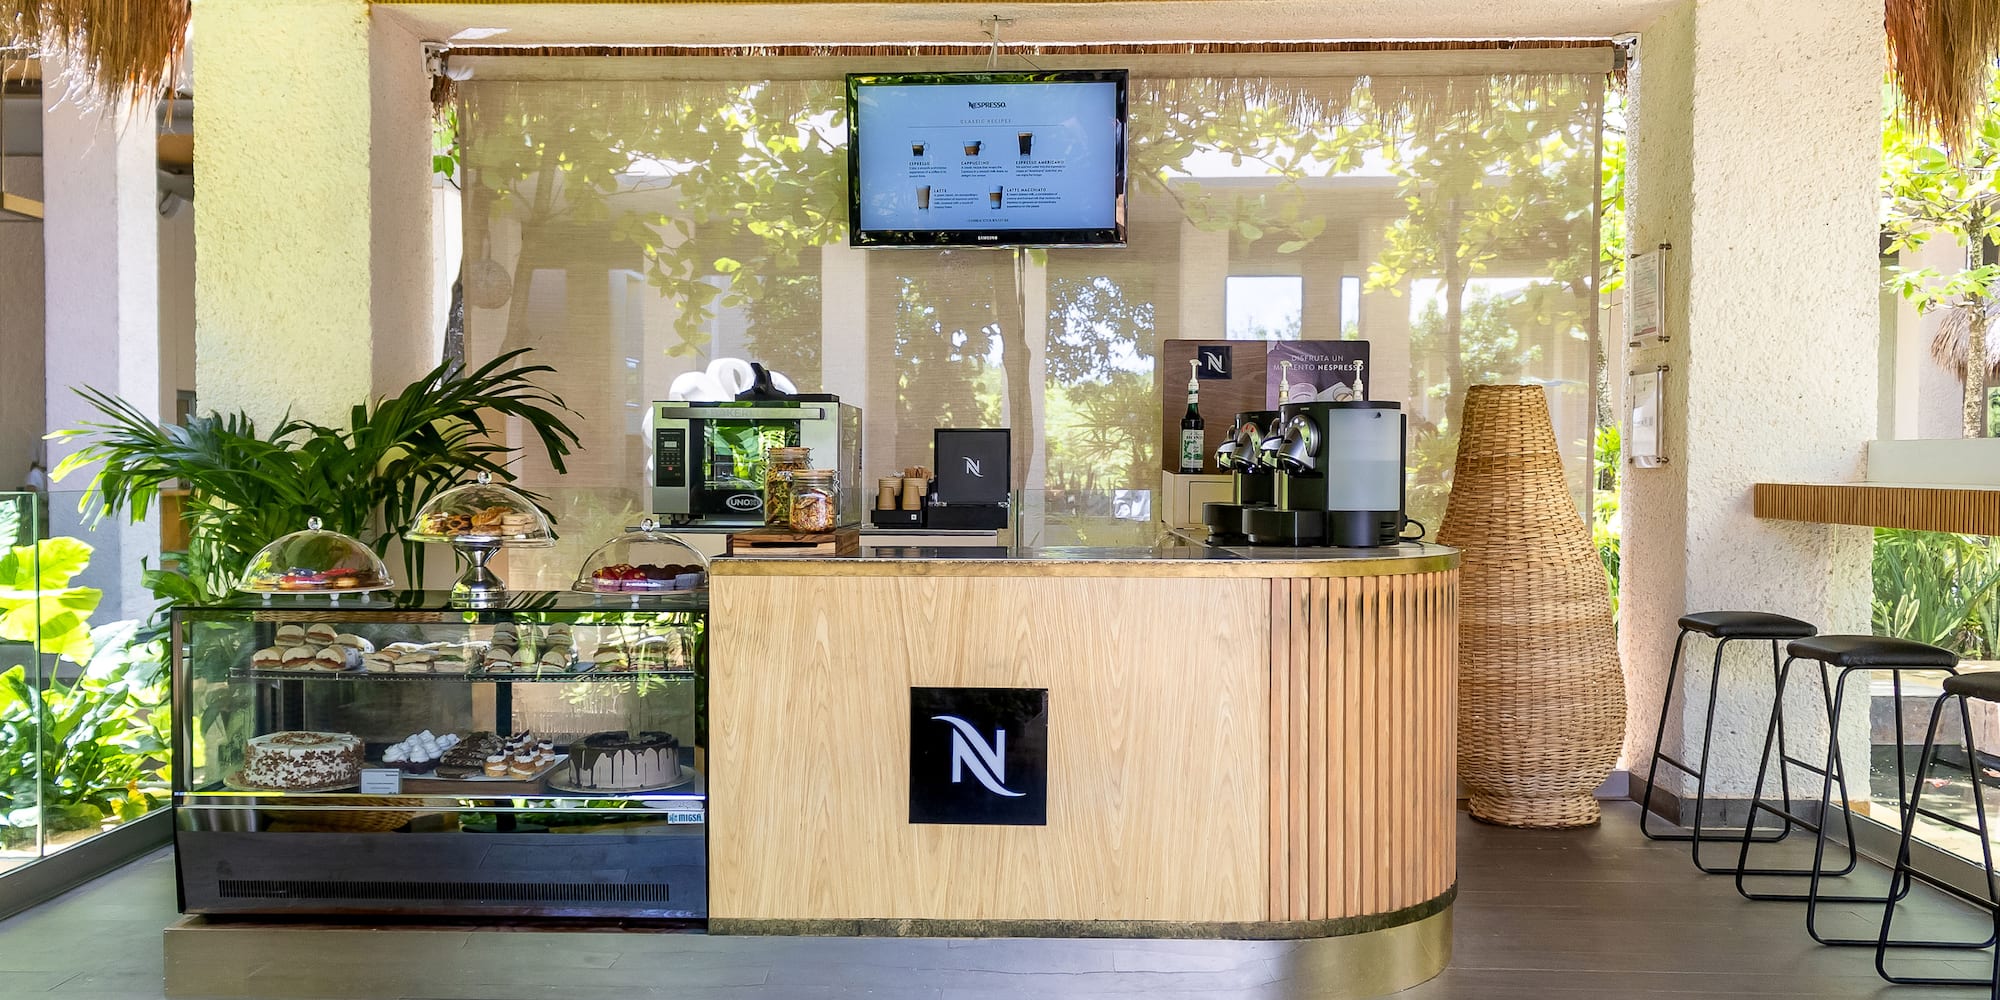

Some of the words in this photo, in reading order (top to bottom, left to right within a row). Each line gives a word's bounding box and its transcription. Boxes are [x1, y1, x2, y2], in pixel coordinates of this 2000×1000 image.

[968, 101, 1006, 109] NESPRESSO
[1291, 354, 1329, 362] DISFRUTA
[1317, 363, 1364, 371] NESPRESSO
[931, 715, 1027, 797] N
[678, 813, 702, 822] MIGSA
